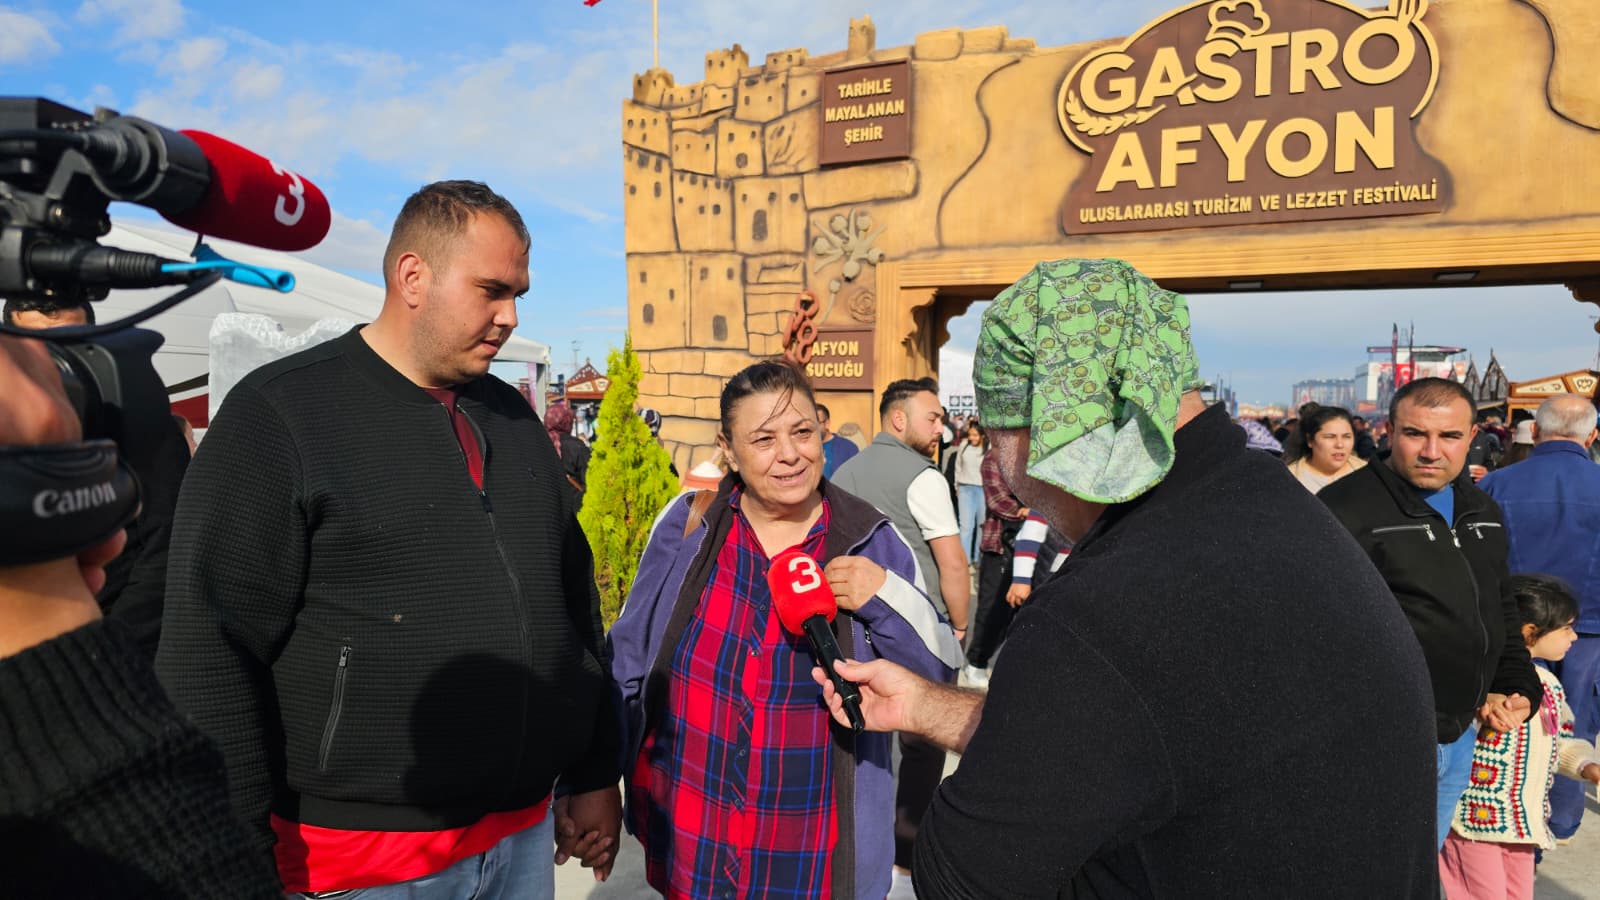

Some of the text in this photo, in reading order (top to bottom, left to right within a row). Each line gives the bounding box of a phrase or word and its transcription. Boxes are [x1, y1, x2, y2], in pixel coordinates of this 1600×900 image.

[1079, 18, 1416, 114] GASTRO
[838, 78, 892, 98] TARİHLE
[825, 100, 904, 122] MAYALANAN
[844, 123, 883, 146] ŞEHİR
[1096, 106, 1395, 192] AFYON
[1079, 178, 1438, 223] ULUSLARARASI TURİZM VE LEZZET FESTİVALİ
[811, 342, 858, 355] AFYON
[806, 360, 863, 377] SUCUĞU
[32, 482, 117, 518] Canon
[788, 556, 821, 594] 3
